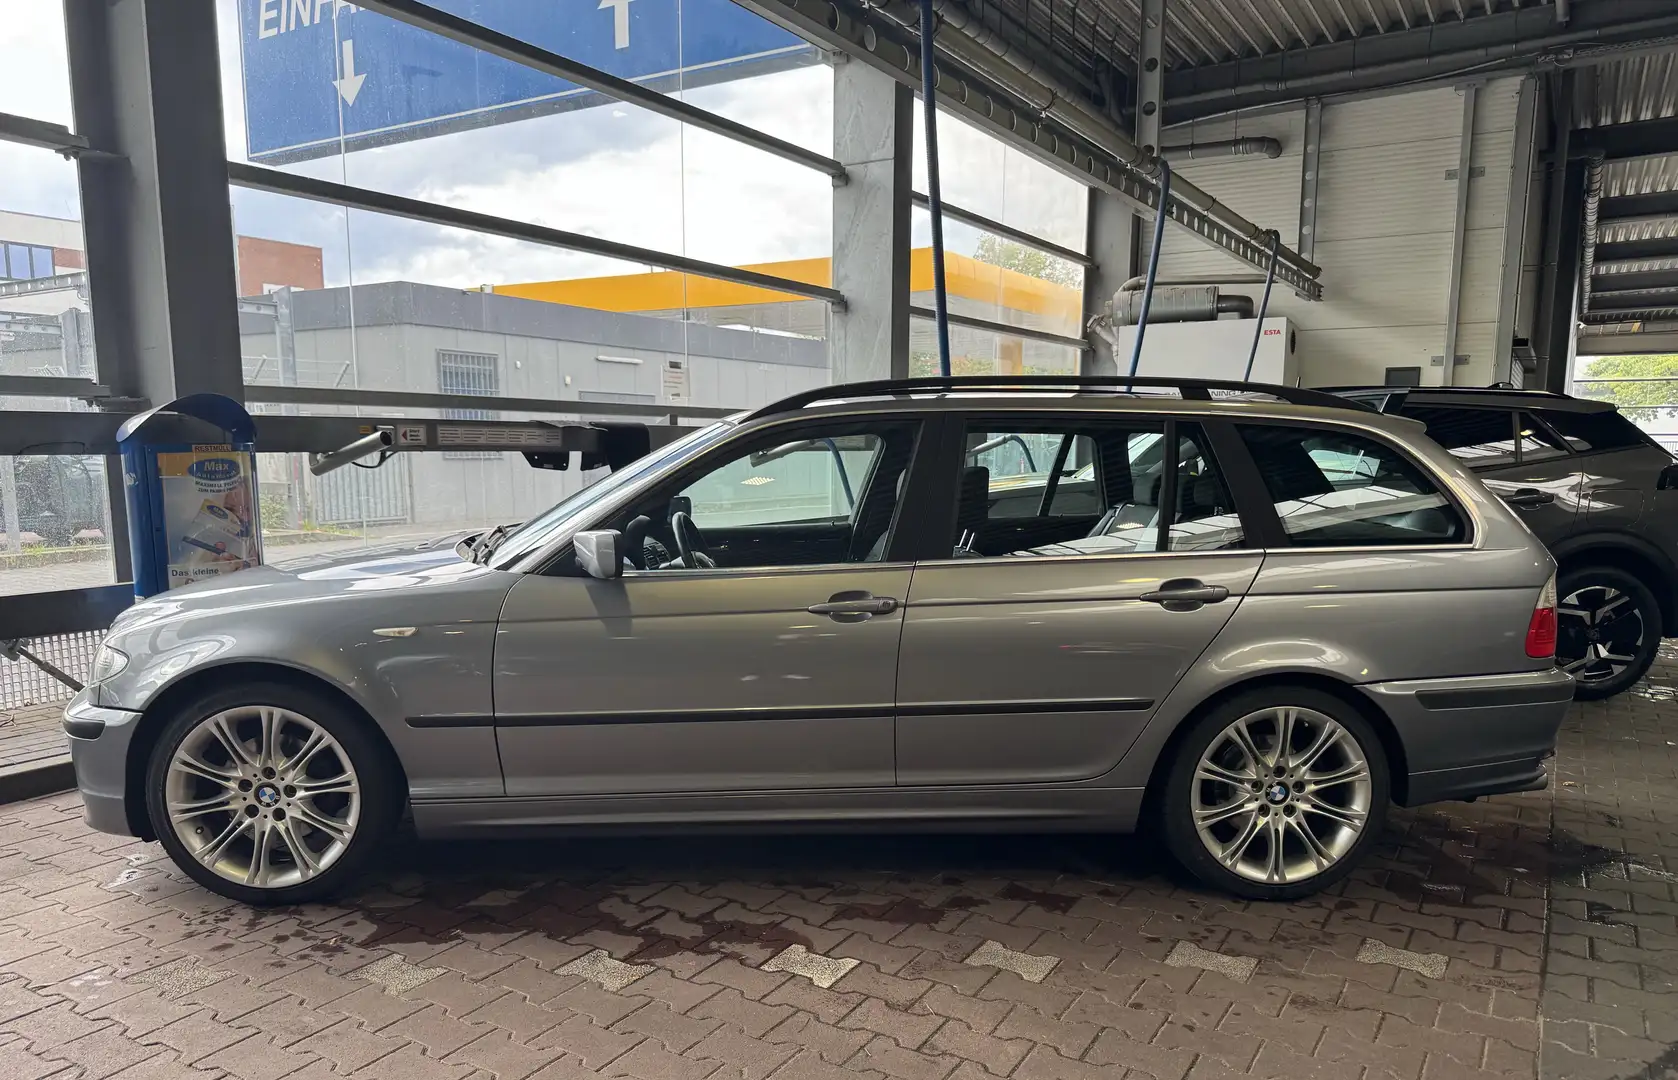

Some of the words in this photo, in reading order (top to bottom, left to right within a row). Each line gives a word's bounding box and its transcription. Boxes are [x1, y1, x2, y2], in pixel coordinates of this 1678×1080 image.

[204, 461, 229, 471] Max
[171, 569, 189, 577] Das
[192, 567, 220, 576] kleine
